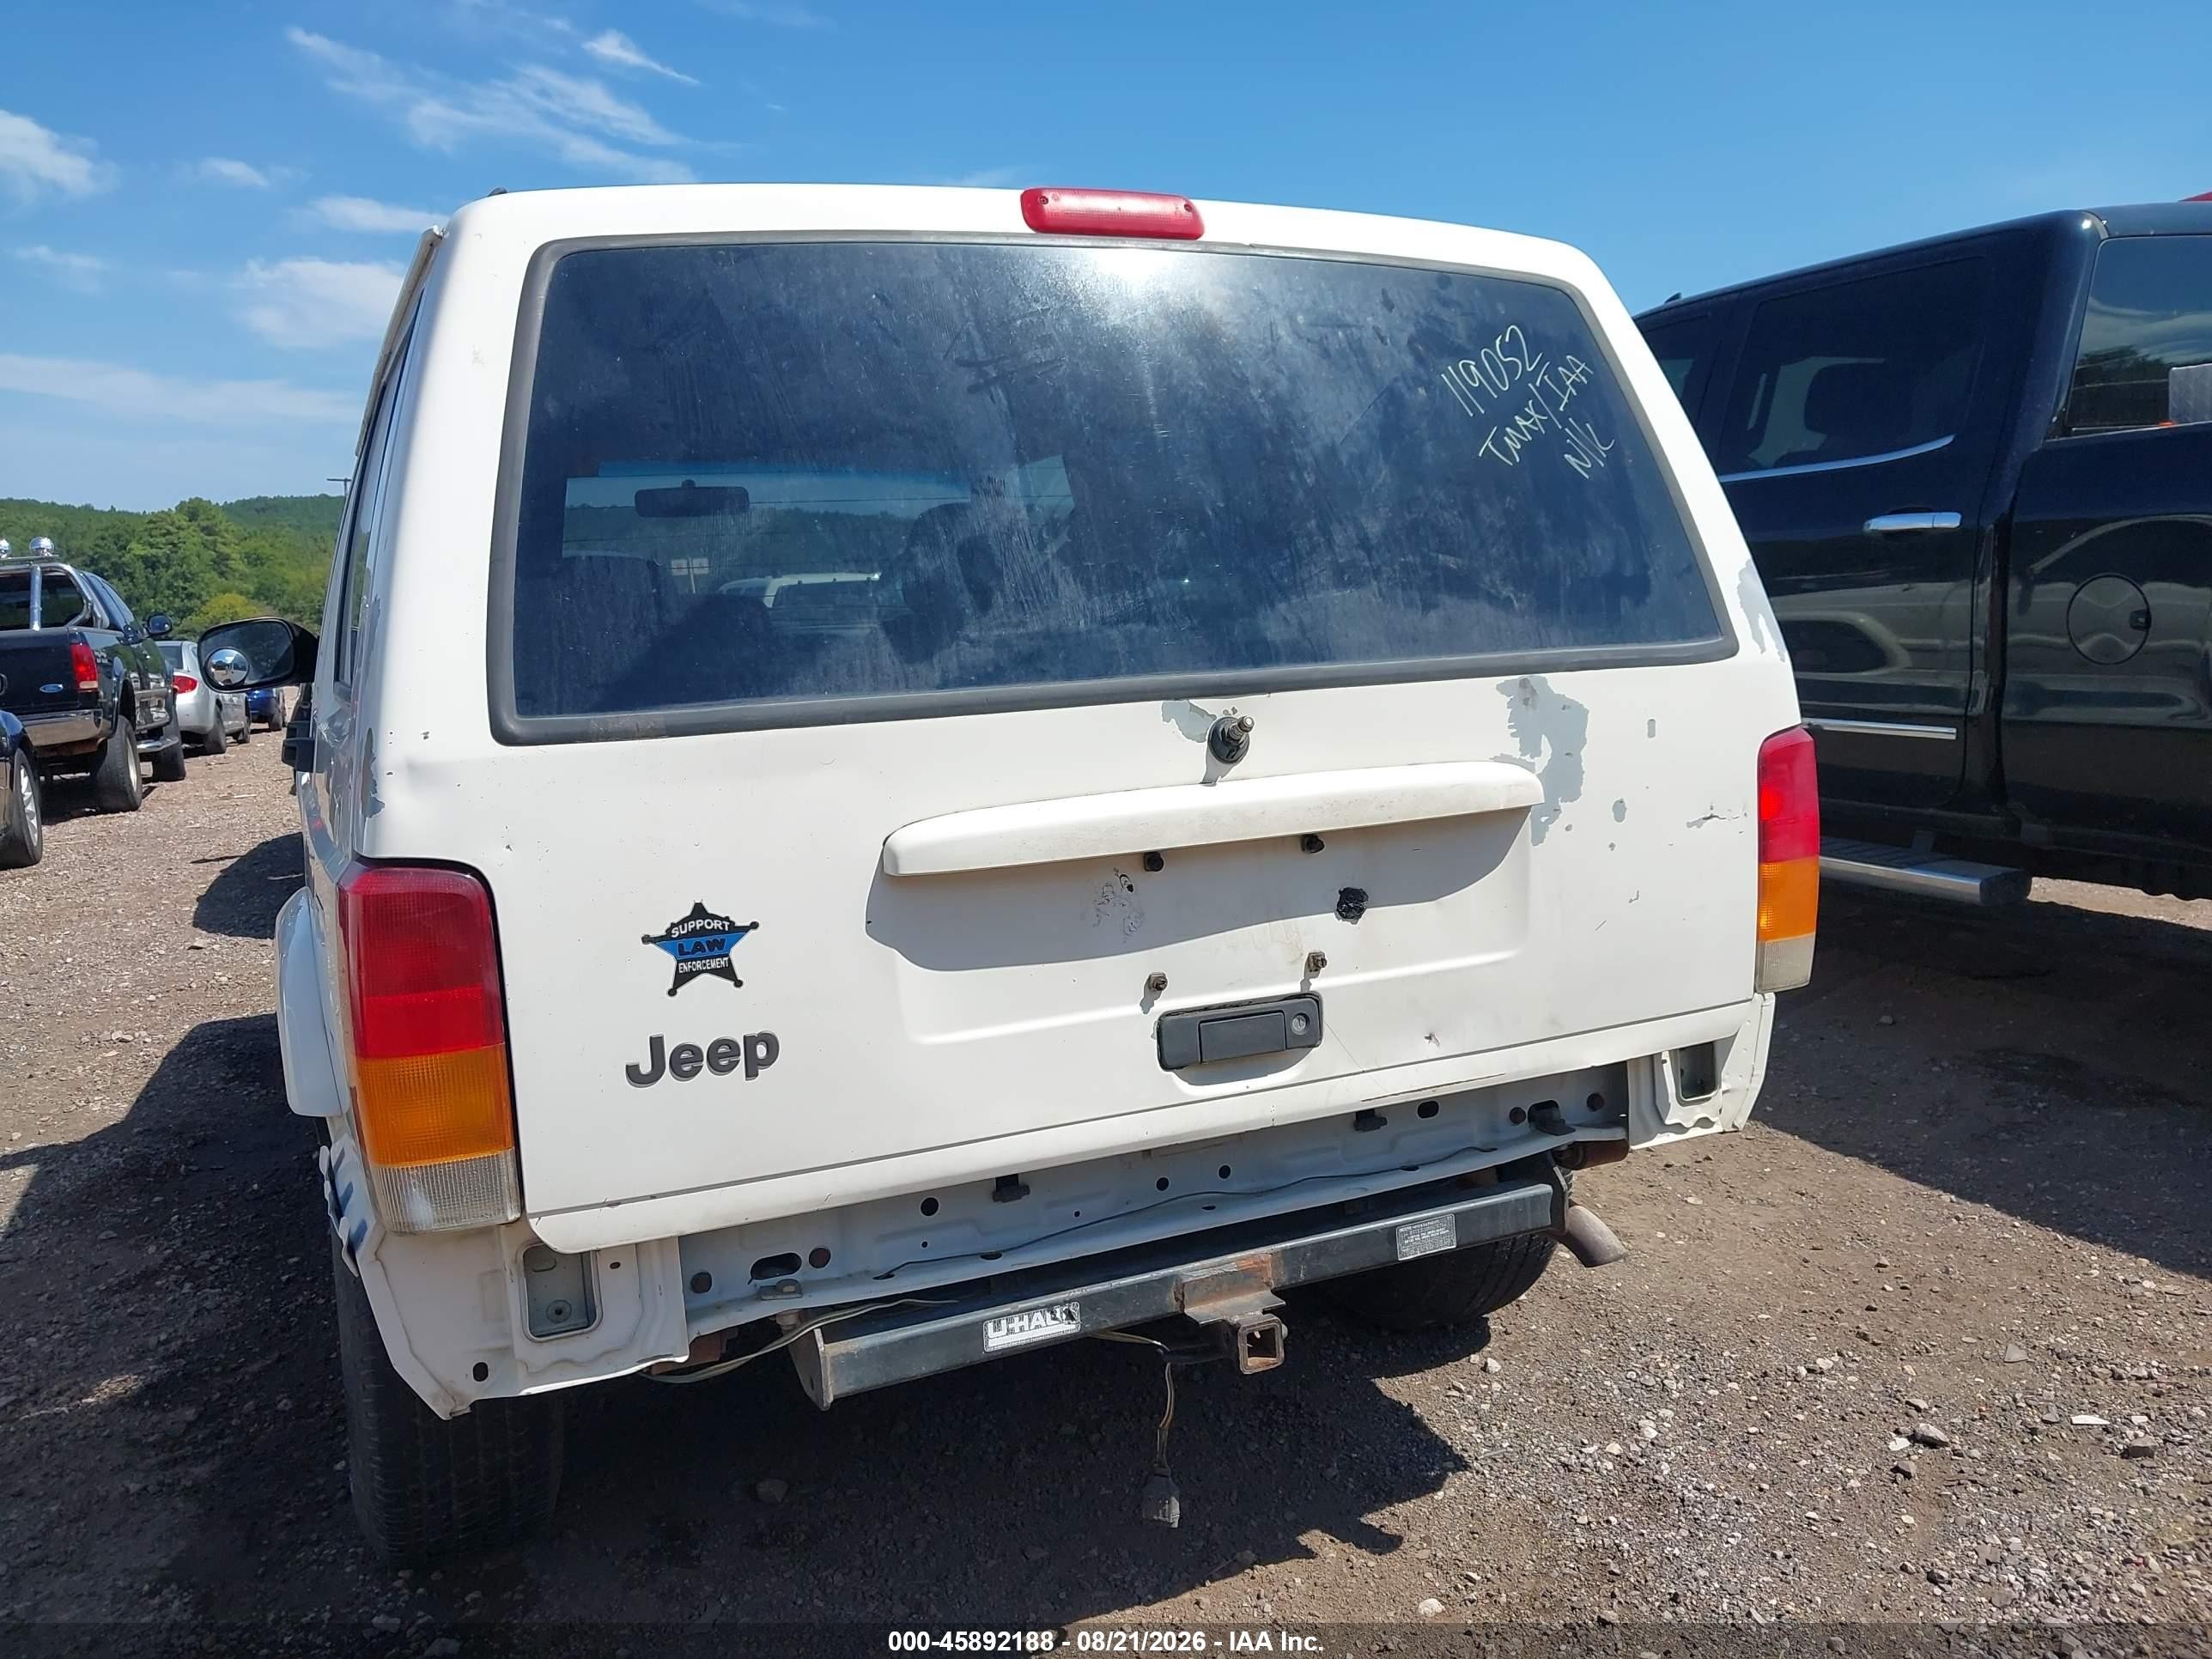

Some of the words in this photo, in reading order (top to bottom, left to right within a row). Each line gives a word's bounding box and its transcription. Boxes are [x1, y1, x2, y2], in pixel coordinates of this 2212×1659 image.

[1441, 325, 1543, 417] 119052
[671, 919, 730, 939] SUPPORT
[678, 937, 726, 957] LAW
[678, 957, 730, 974] ENFORCEMENT
[625, 1030, 780, 1088] Jeep
